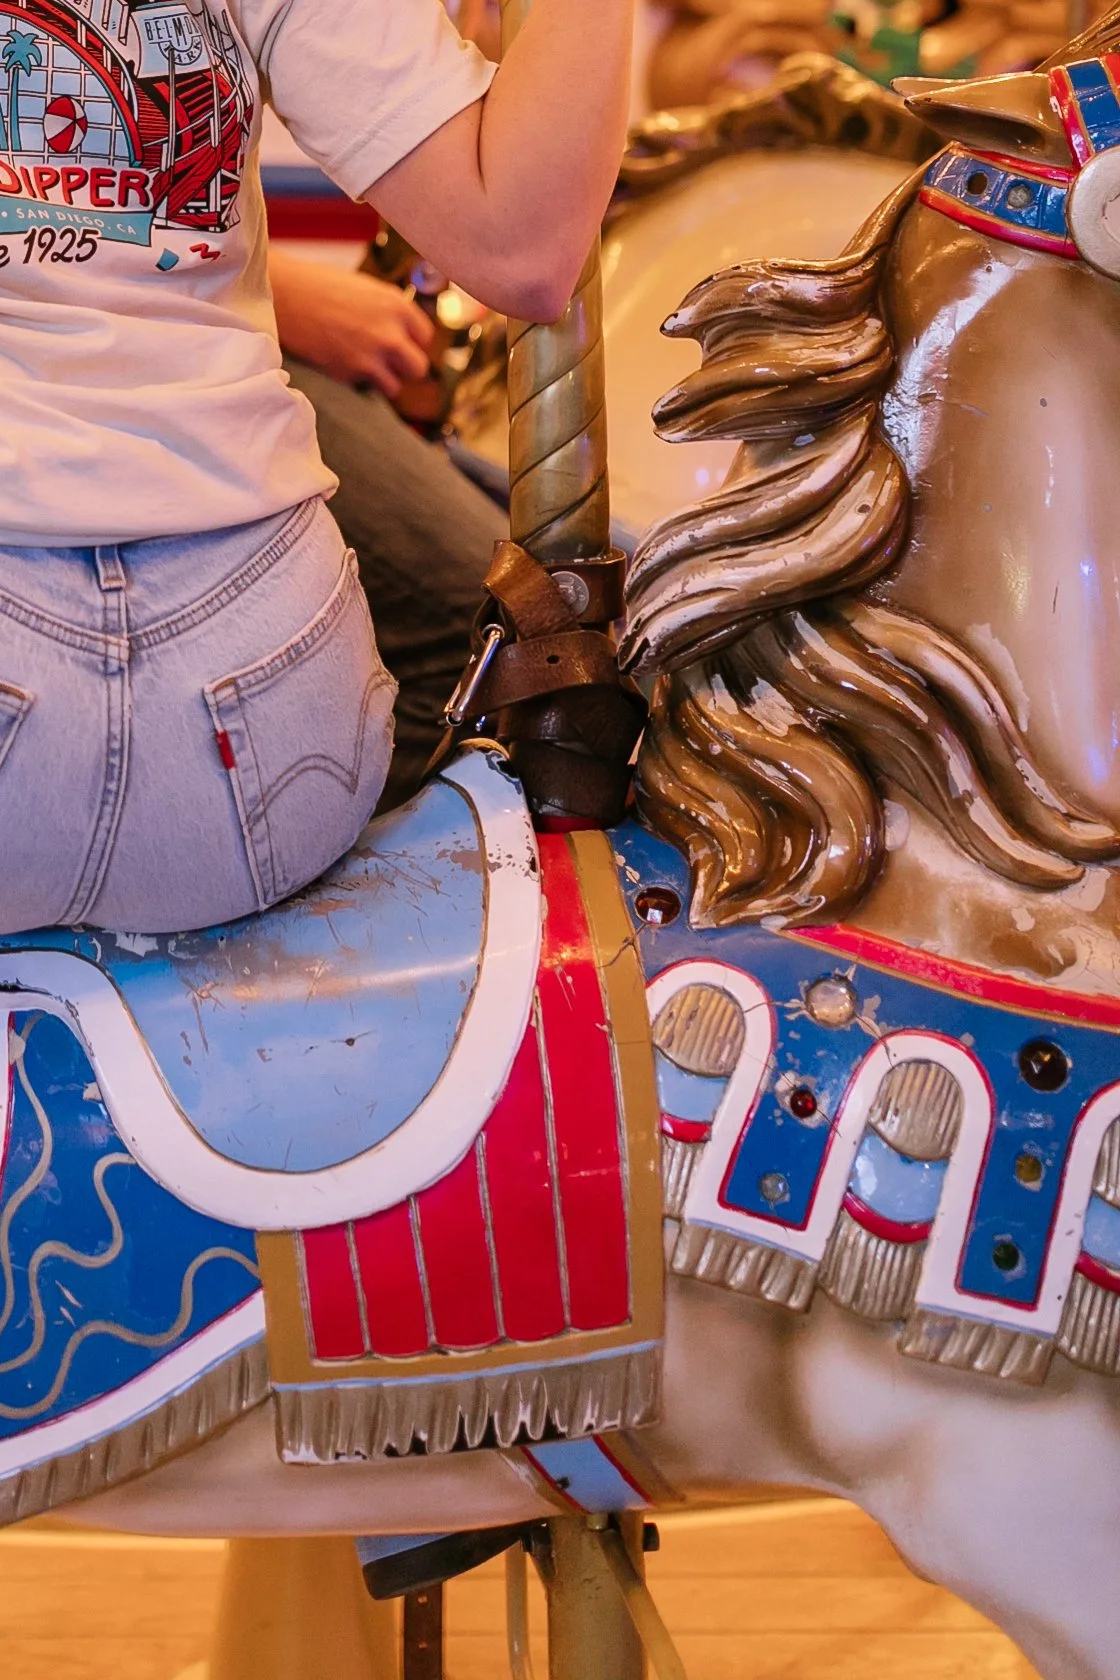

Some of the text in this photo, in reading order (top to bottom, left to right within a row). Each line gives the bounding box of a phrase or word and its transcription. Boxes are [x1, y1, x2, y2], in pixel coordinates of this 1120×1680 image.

[16, 207, 50, 220] SAN
[117, 224, 137, 236] CA
[22, 227, 100, 264] 1925
